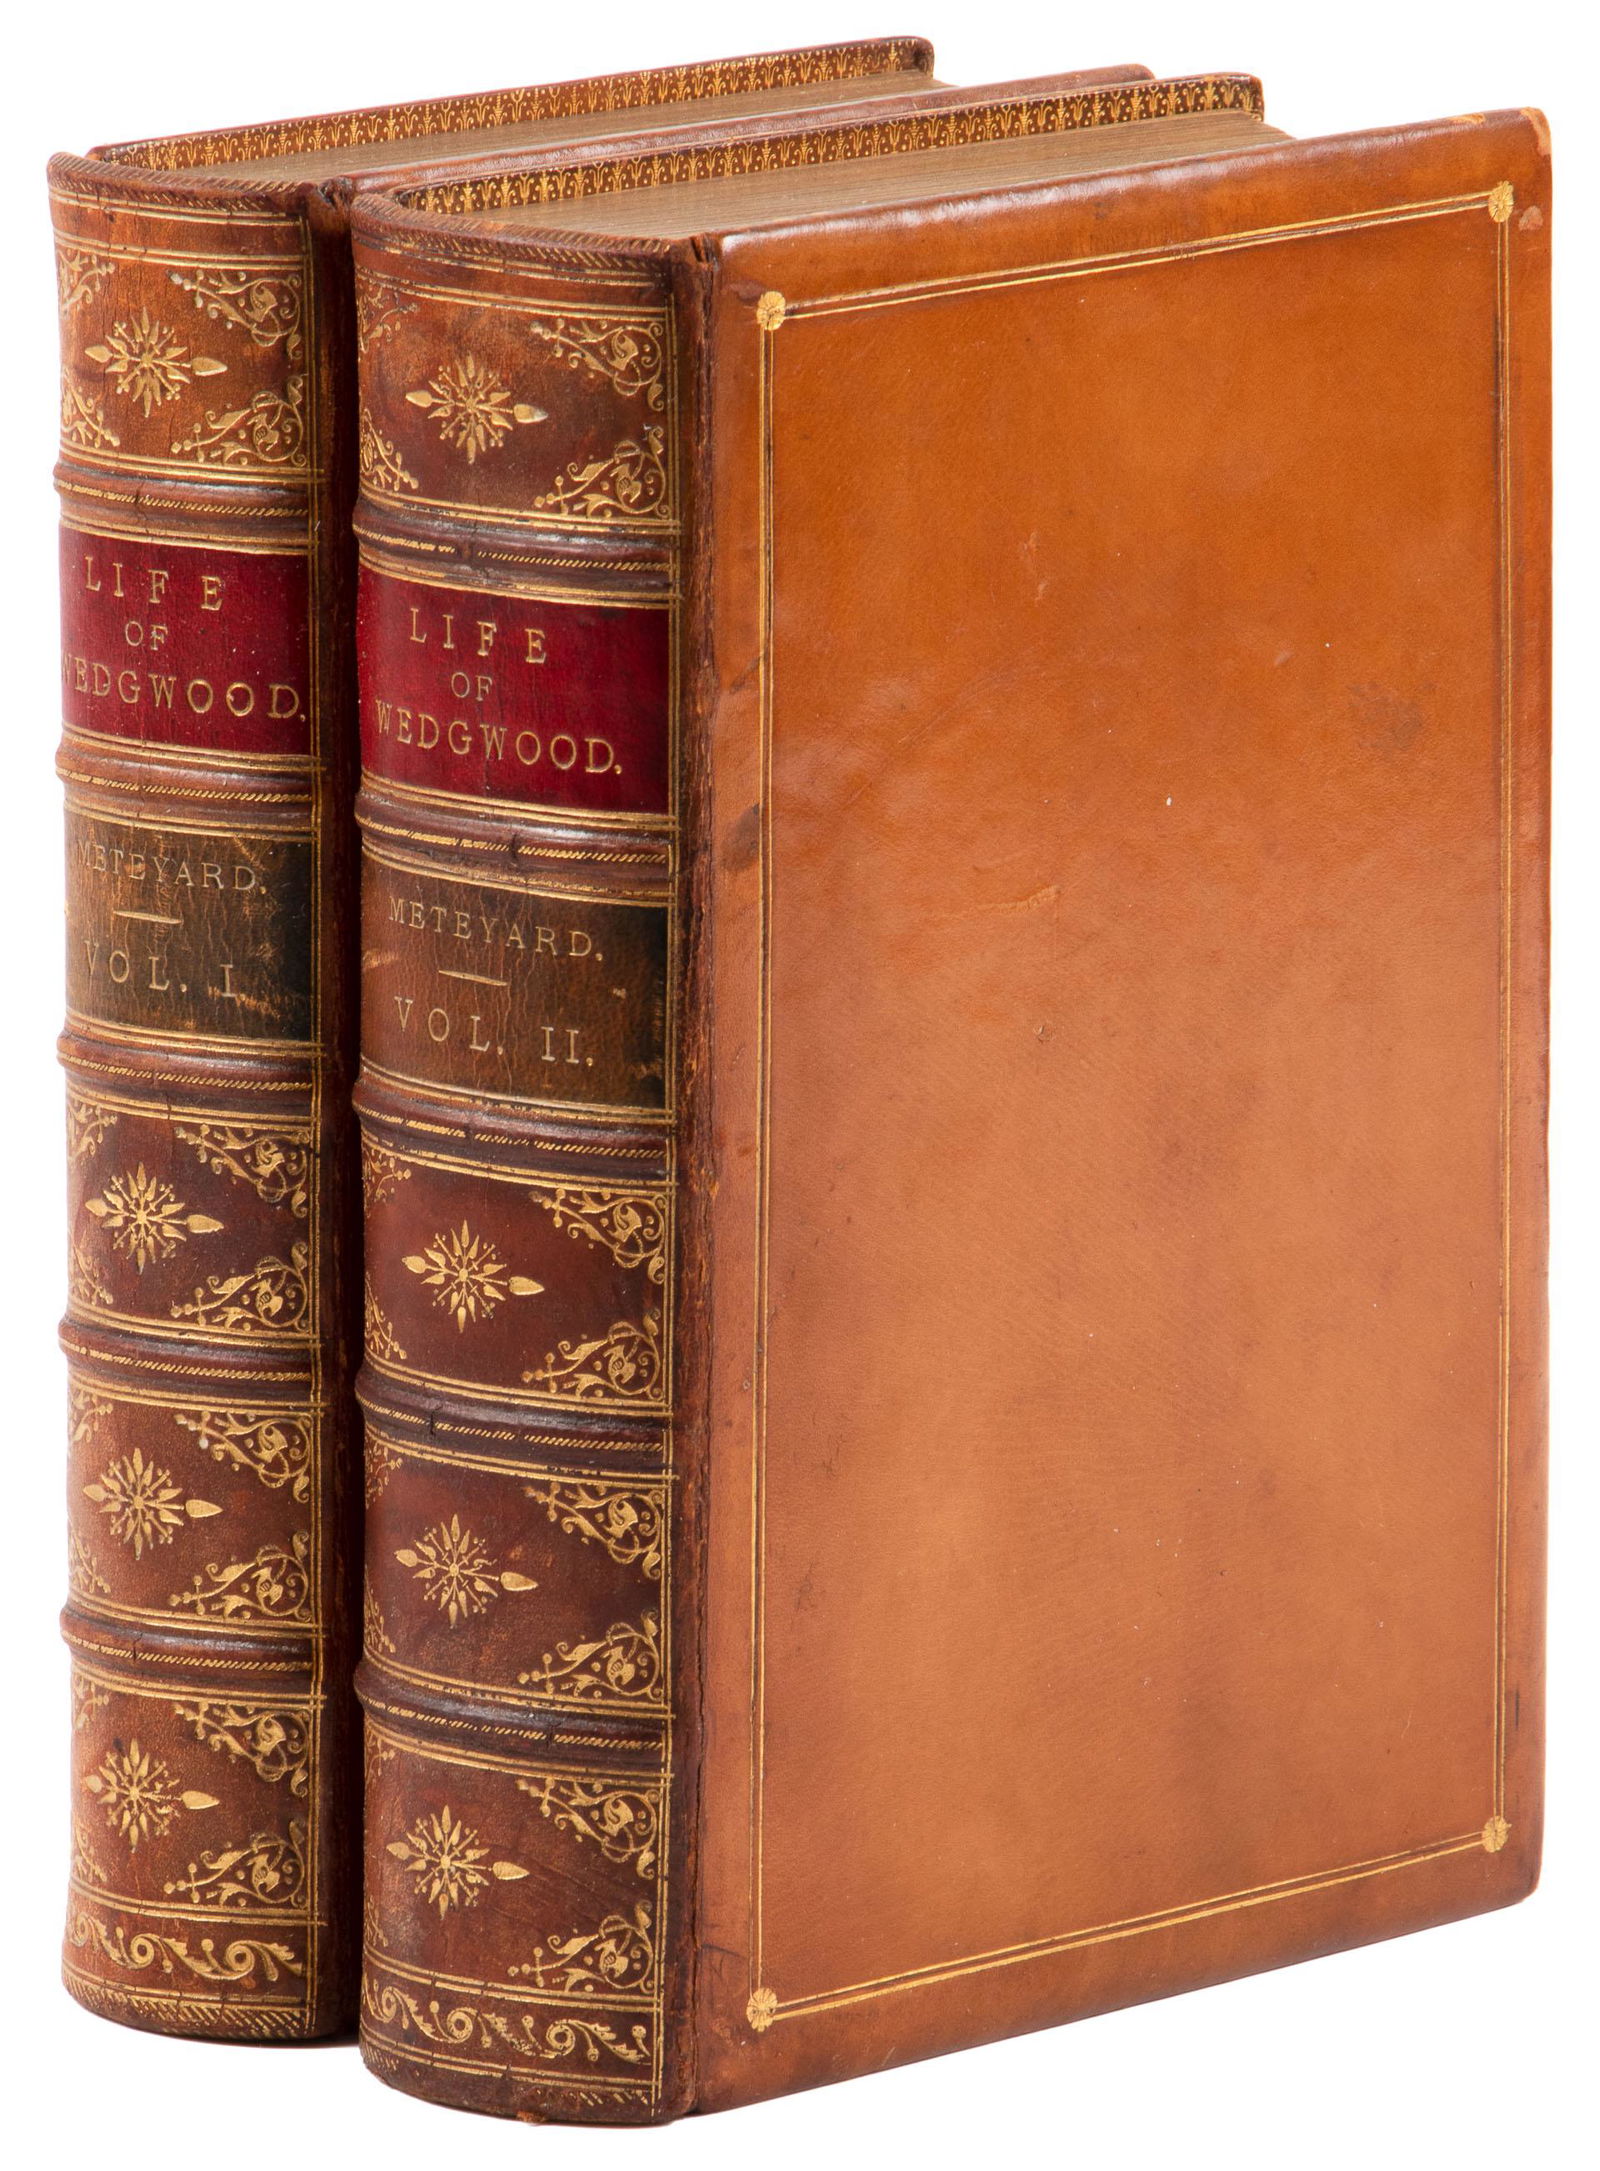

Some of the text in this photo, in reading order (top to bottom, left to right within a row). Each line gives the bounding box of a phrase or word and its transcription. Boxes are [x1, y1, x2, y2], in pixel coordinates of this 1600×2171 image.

[84, 556, 225, 611] LIFE
[124, 620, 169, 650] OF
[409, 608, 546, 664] LIFE
[450, 672, 493, 701] OF
[375, 699, 622, 775] WEDGWOOD.
[77, 839, 267, 895] METEYARD.
[389, 895, 603, 961] METEYARD.
[84, 940, 187, 992] VOL.
[394, 995, 594, 1067] VOL. II.
